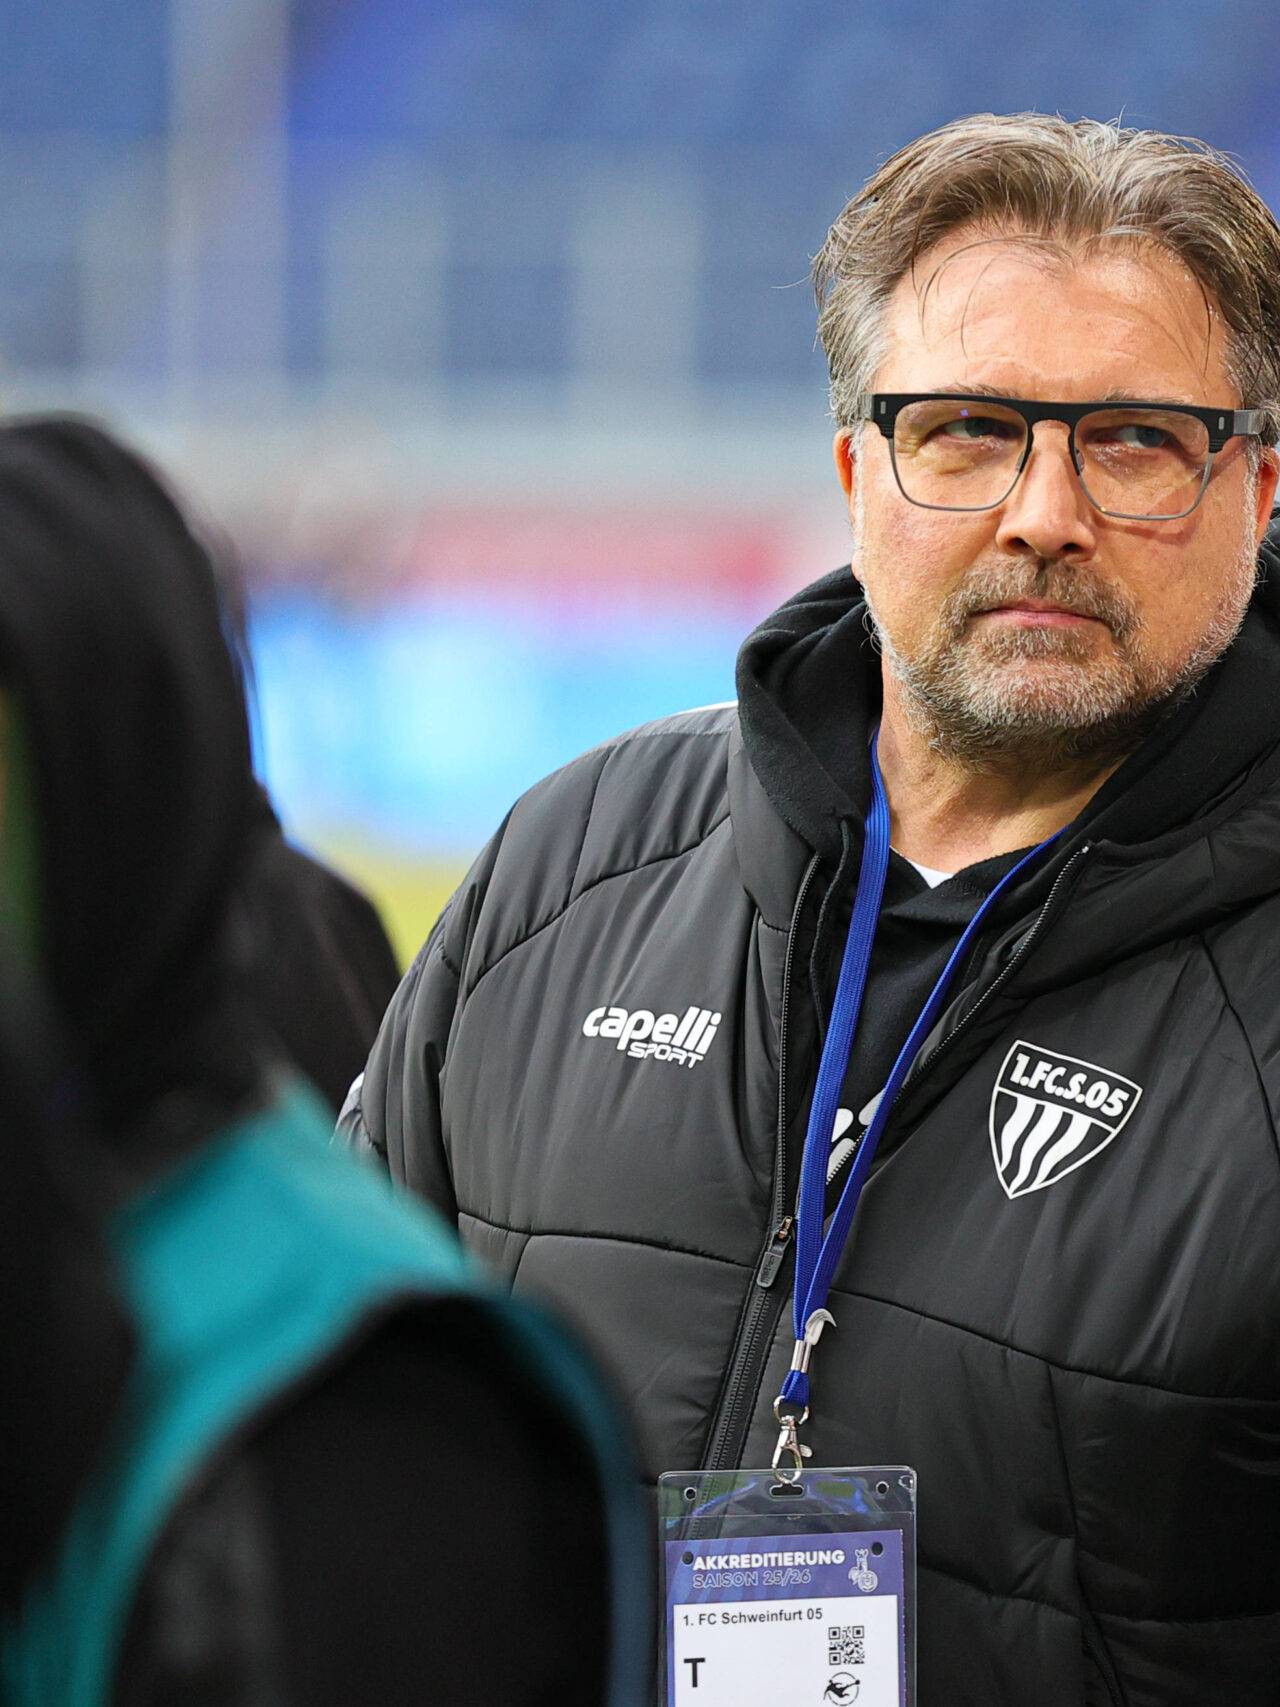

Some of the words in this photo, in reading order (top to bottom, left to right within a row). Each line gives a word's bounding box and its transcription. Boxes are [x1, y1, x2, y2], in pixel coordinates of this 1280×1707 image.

[582, 1006, 722, 1055] capelli
[627, 1041, 704, 1069] SPORT
[692, 1549, 846, 1571] AKKREDITIERUNG
[693, 1571, 758, 1588] SAISON
[763, 1568, 812, 1587] 25/26
[683, 1614, 694, 1626] 1.
[698, 1613, 717, 1625] FC
[721, 1609, 802, 1625] Schweinfurt
[806, 1607, 823, 1620] 05
[683, 1657, 706, 1688] T
